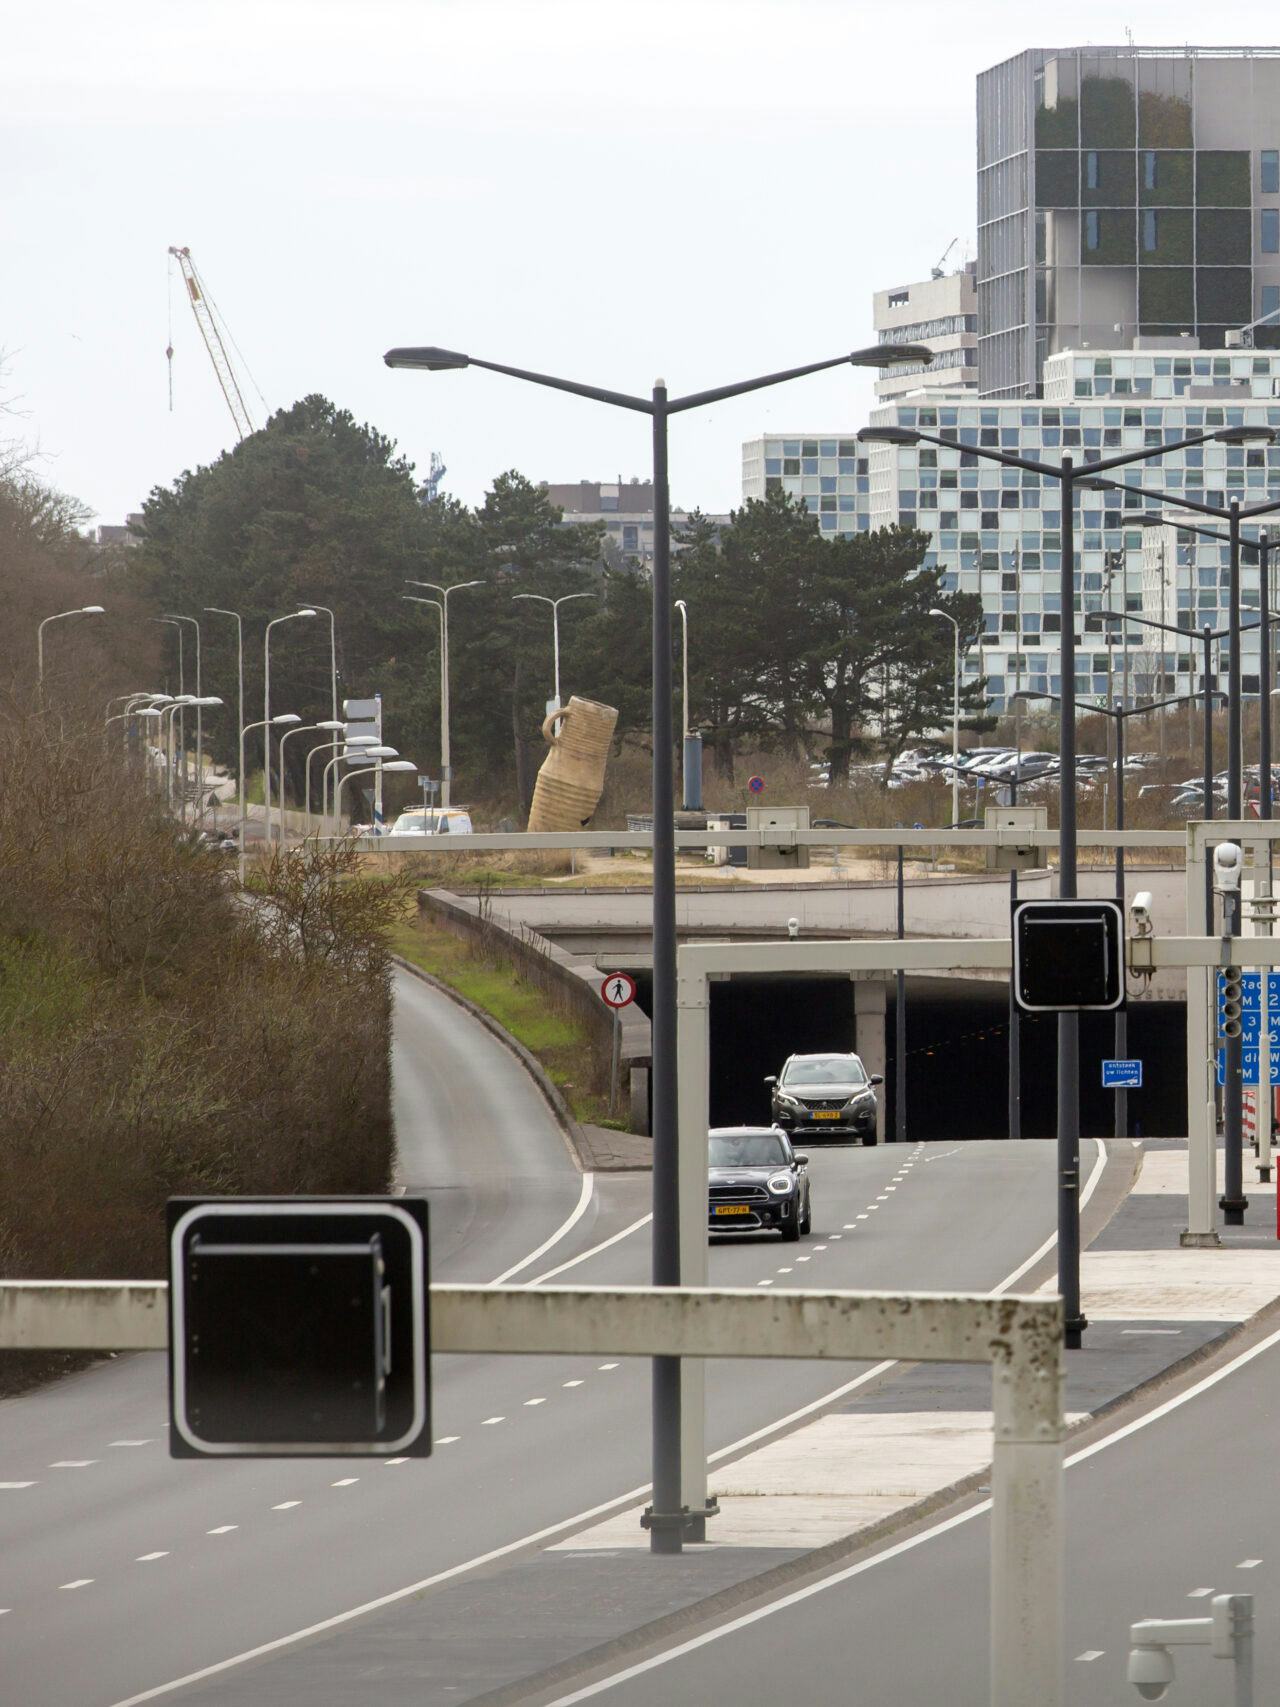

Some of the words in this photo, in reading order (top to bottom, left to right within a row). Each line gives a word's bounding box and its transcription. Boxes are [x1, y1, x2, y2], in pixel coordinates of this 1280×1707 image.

[1242, 995, 1252, 1006] M
[1242, 1031, 1252, 1043] M
[1242, 1068, 1252, 1079] M
